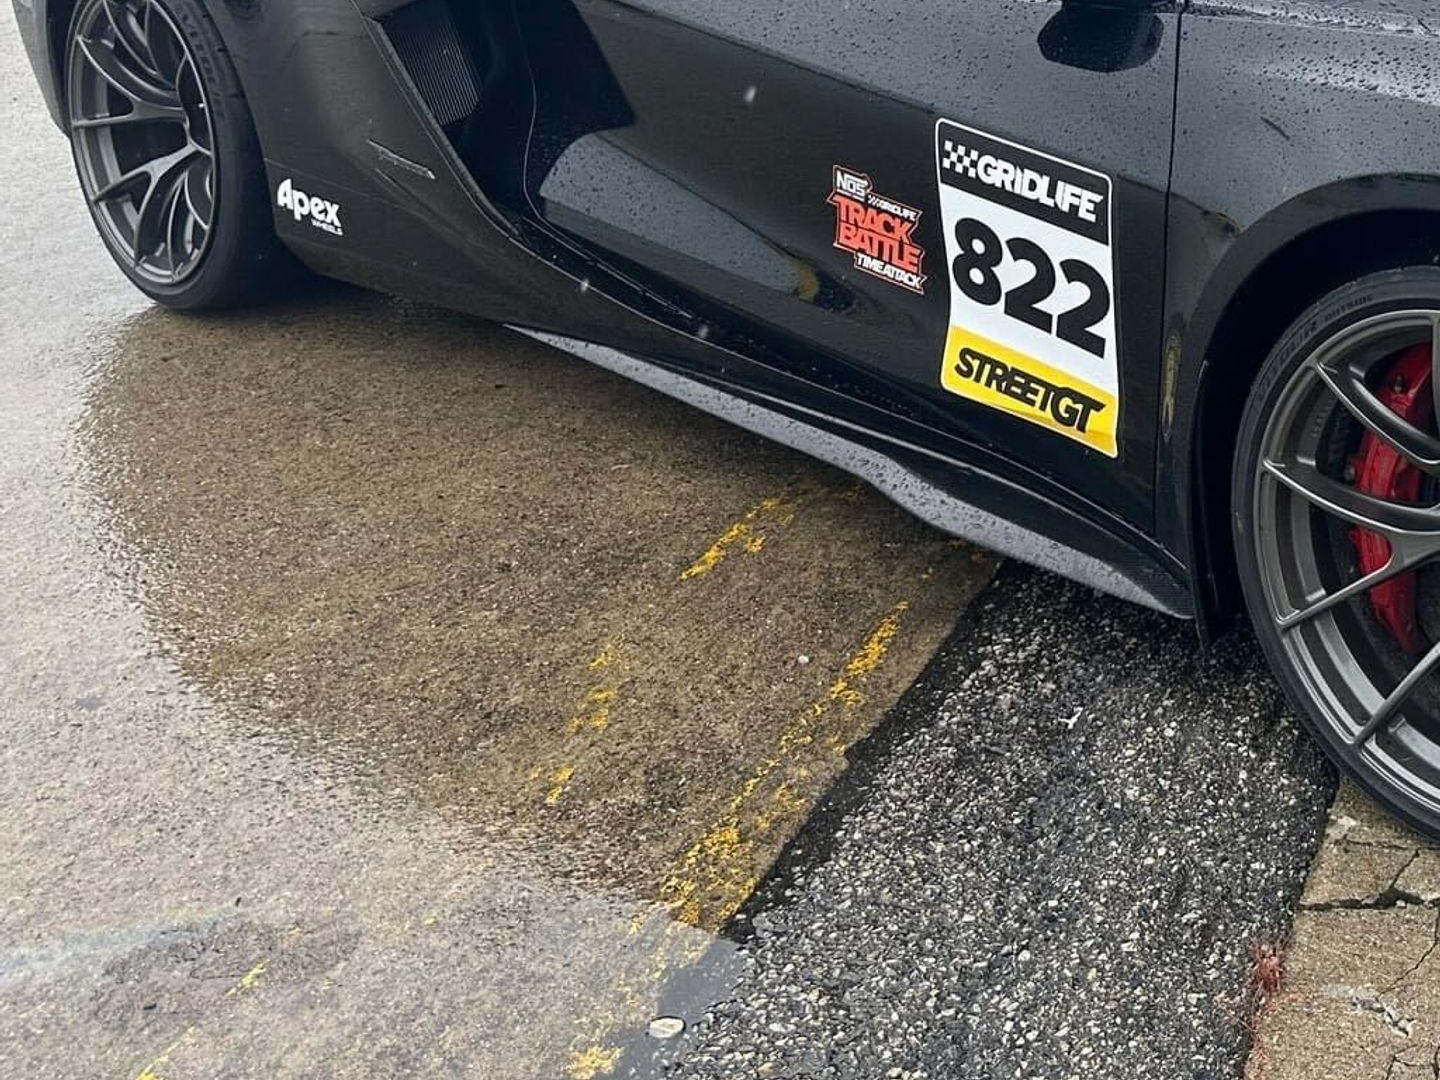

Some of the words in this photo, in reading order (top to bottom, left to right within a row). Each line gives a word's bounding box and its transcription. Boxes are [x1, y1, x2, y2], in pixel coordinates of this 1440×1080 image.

[277, 178, 342, 228] Apex
[977, 154, 1104, 223] GRIDLIFE
[832, 194, 912, 245] TRACK
[840, 221, 921, 274] BATTLE
[952, 217, 1111, 360] 822
